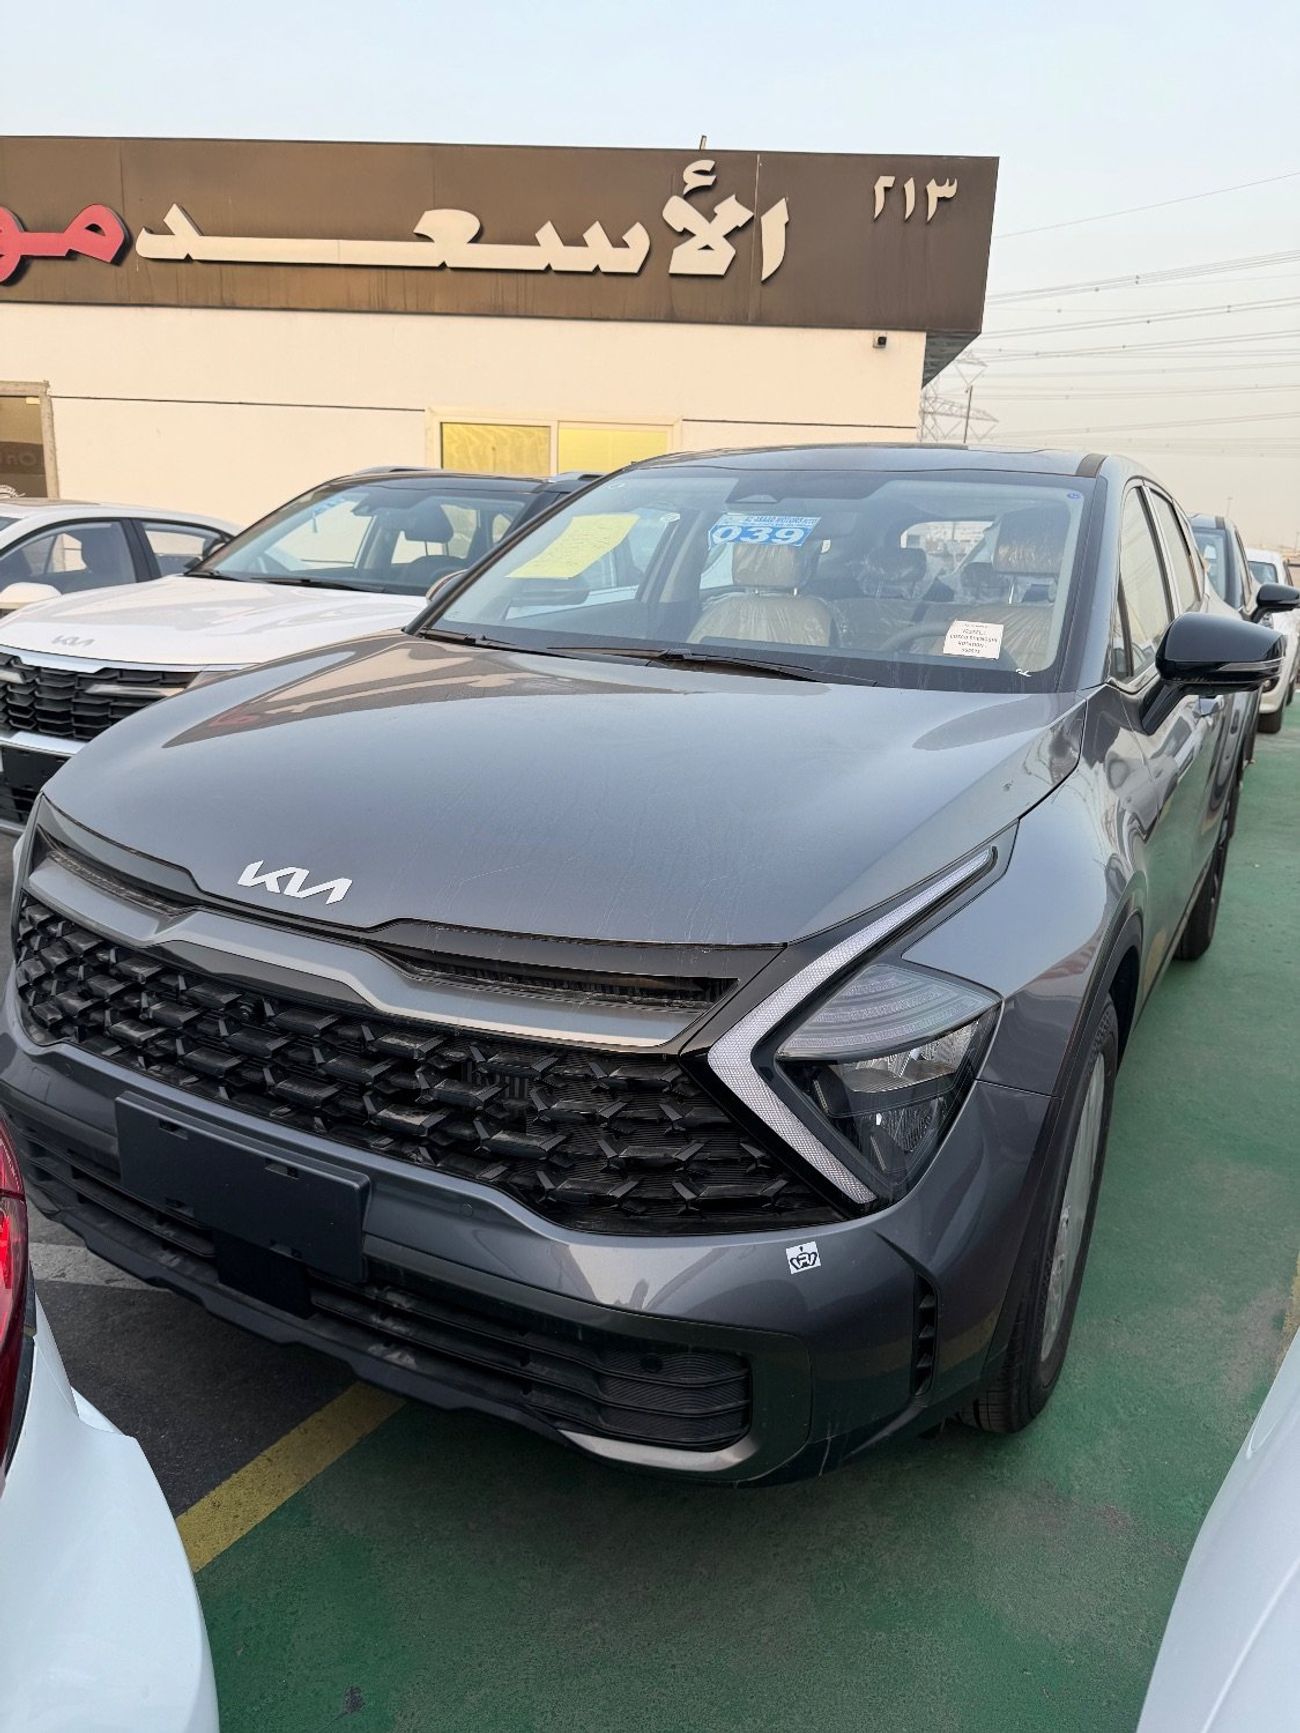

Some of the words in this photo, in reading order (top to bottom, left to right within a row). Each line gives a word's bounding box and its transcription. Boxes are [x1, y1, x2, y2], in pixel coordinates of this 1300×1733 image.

[135, 159, 790, 282] الأسعد
[873, 175, 958, 223] ٢١٣
[712, 525, 805, 545] 039
[237, 859, 353, 905] KIA
